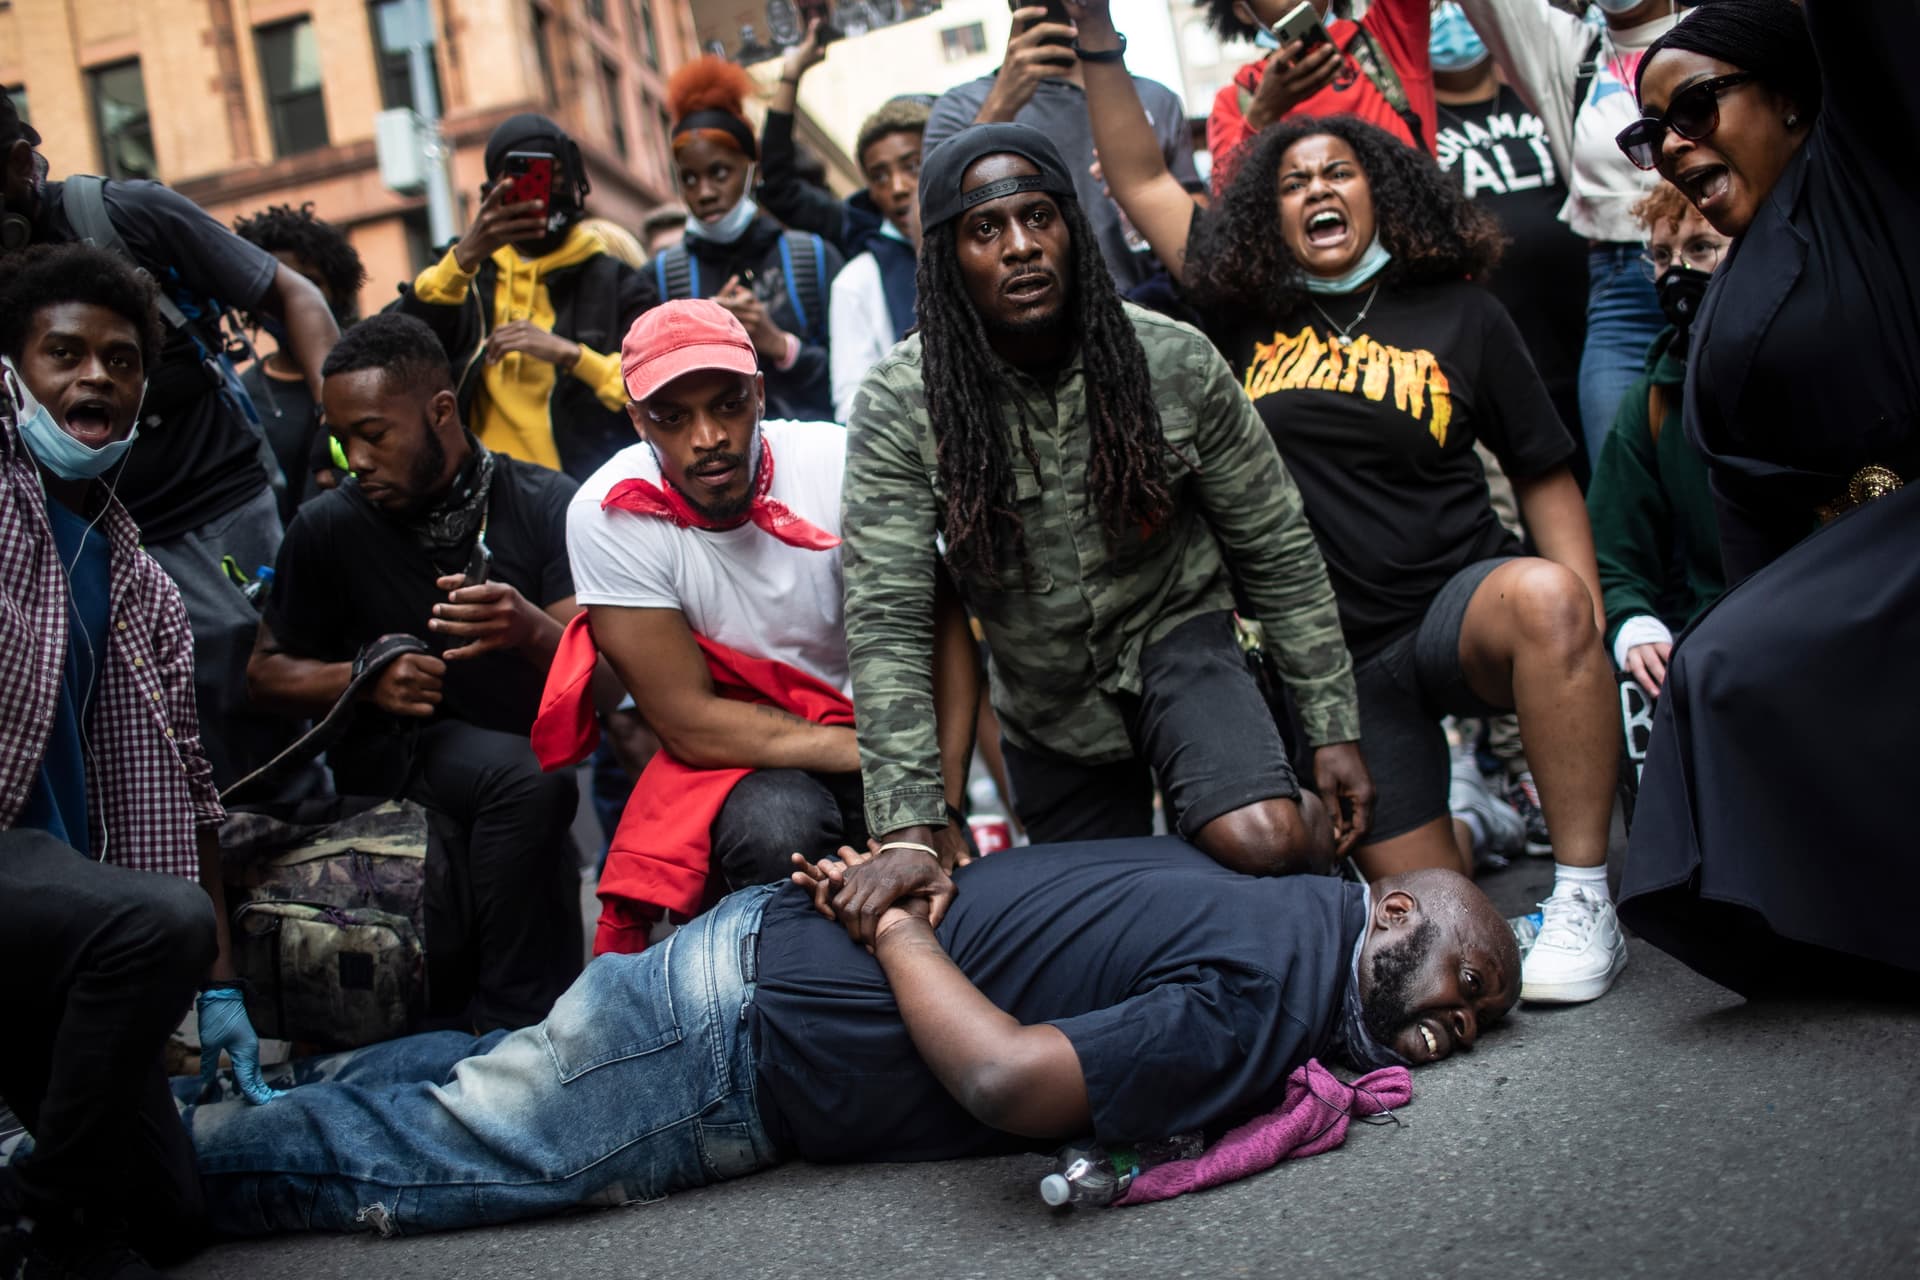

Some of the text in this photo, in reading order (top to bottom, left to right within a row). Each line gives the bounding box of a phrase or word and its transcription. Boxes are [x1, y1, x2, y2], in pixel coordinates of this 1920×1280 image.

[1435, 113, 1549, 173] UHAMM
[1463, 138, 1555, 198] ALI
[1244, 326, 1452, 448] CHINATOWN
[1620, 681, 1653, 759] B
